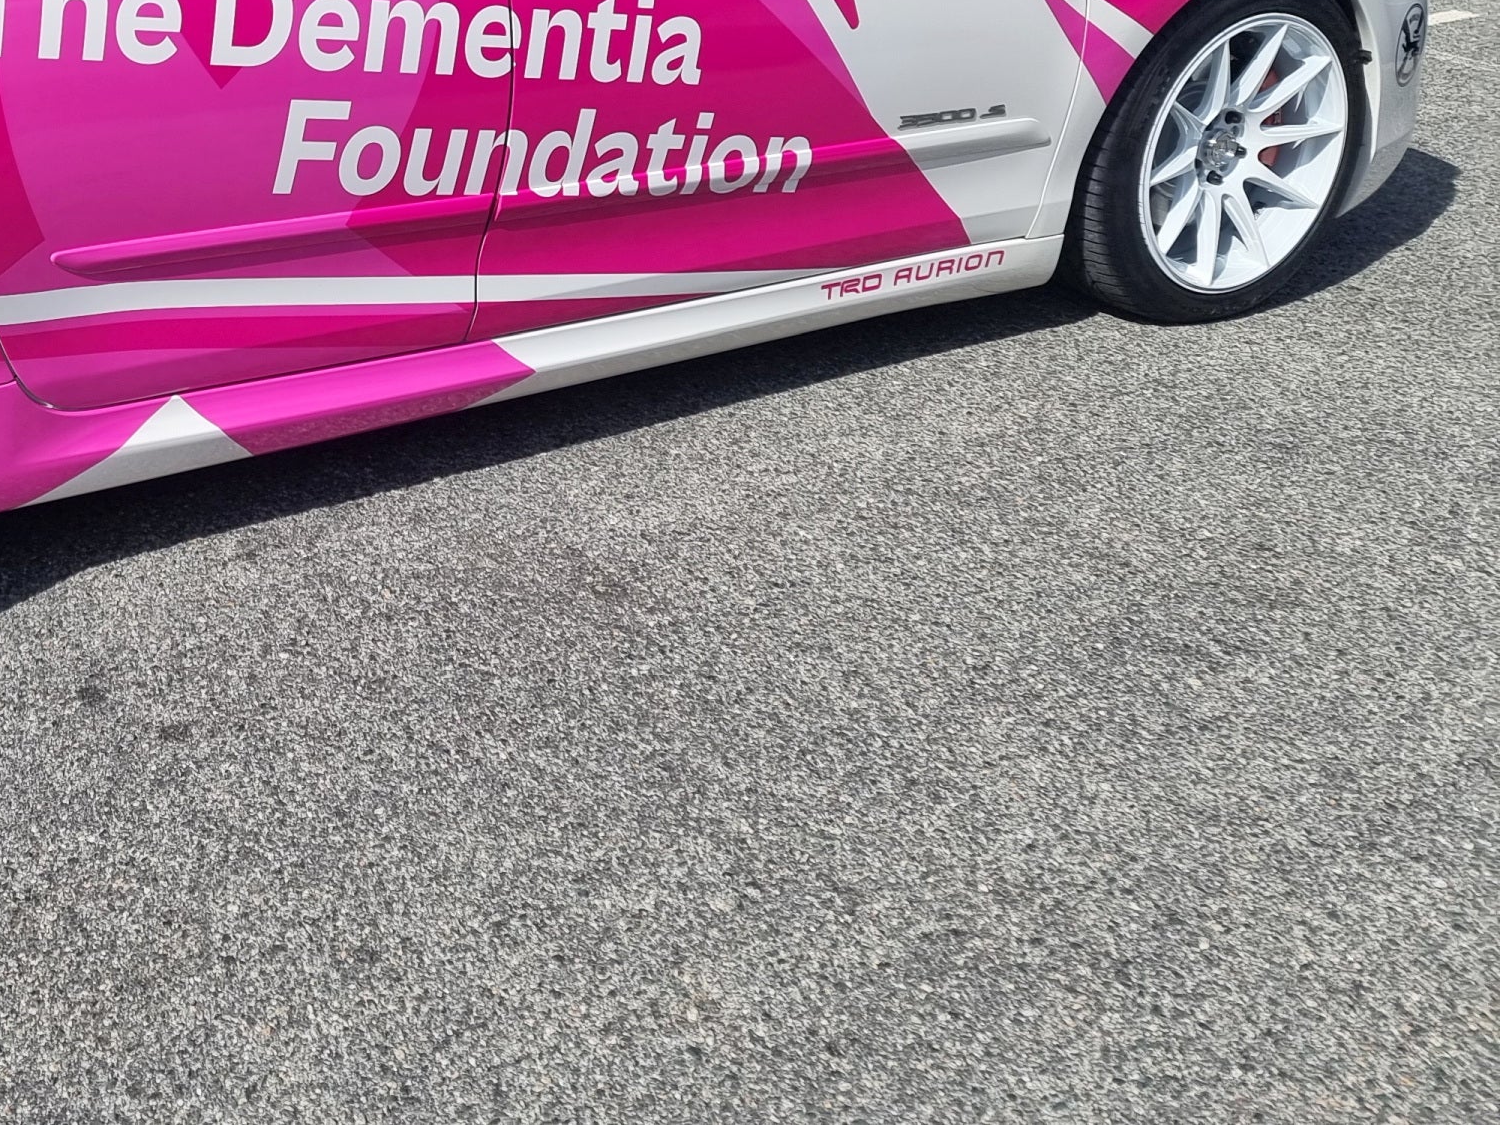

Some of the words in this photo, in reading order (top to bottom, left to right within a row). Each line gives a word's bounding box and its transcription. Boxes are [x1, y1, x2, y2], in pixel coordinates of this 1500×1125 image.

[271, 98, 813, 198] Foundation
[820, 272, 883, 301] TRD
[893, 249, 1005, 287] AURION
